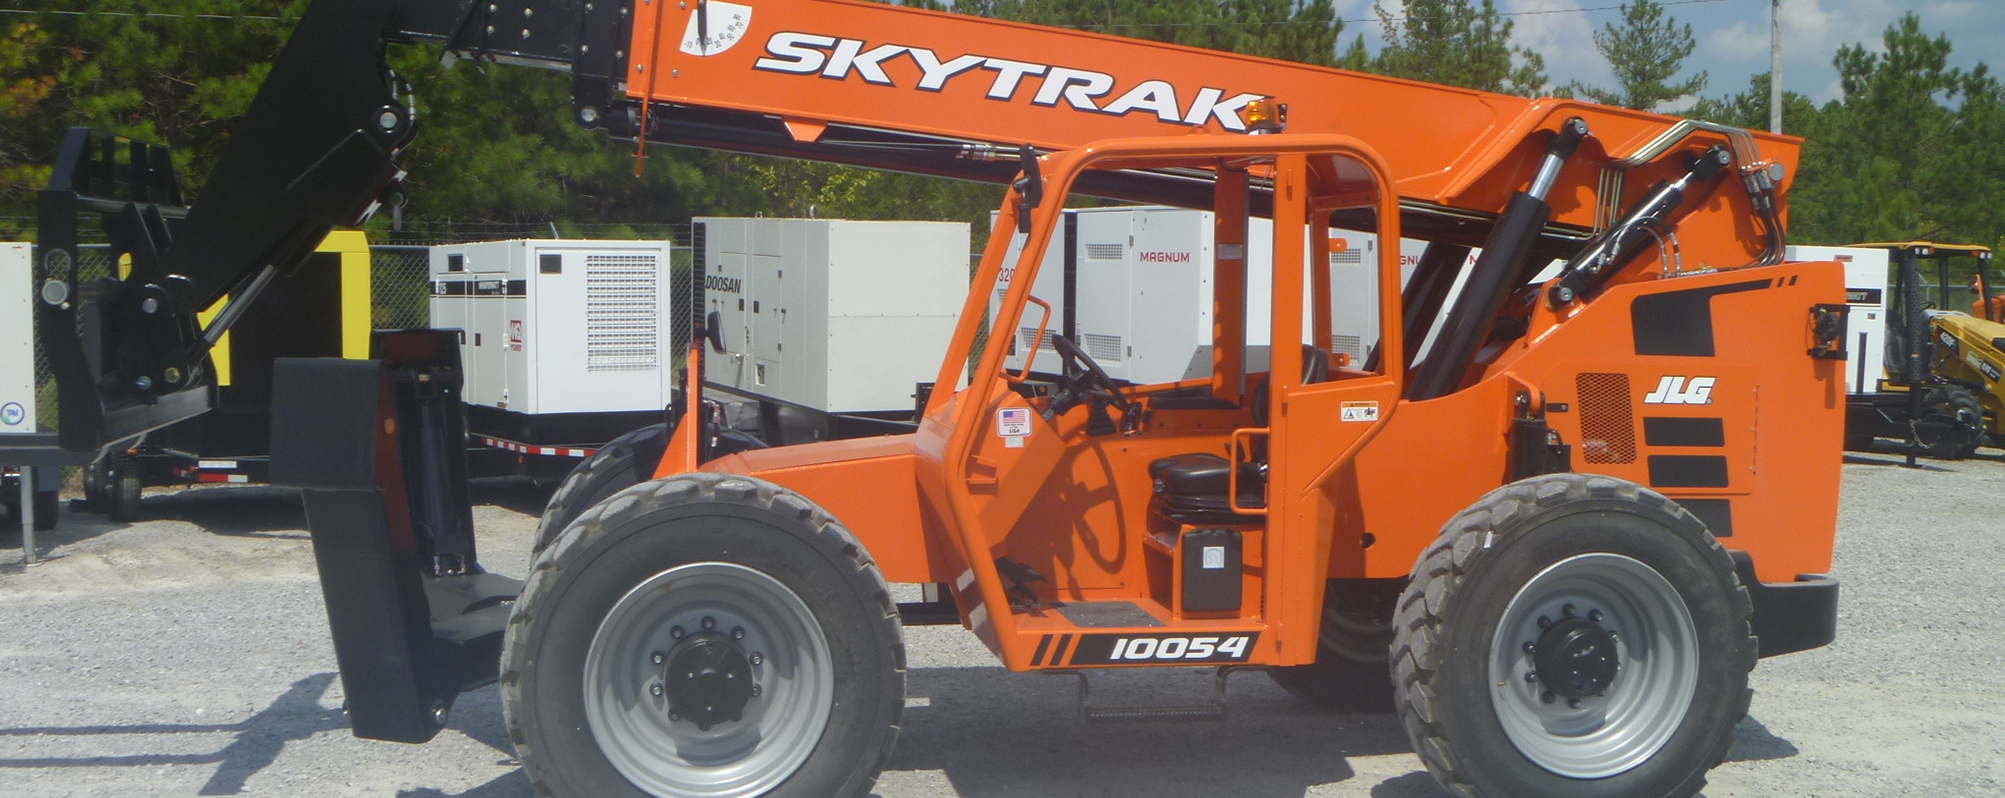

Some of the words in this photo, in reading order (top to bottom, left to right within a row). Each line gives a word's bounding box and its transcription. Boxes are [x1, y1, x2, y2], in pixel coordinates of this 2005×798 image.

[752, 30, 1275, 134] SKYTRAK
[1140, 251, 1190, 263] MAGNUM
[705, 275, 742, 294] DOOSAN
[1643, 375, 1717, 405] JLG
[1110, 636, 1250, 660] 10054
